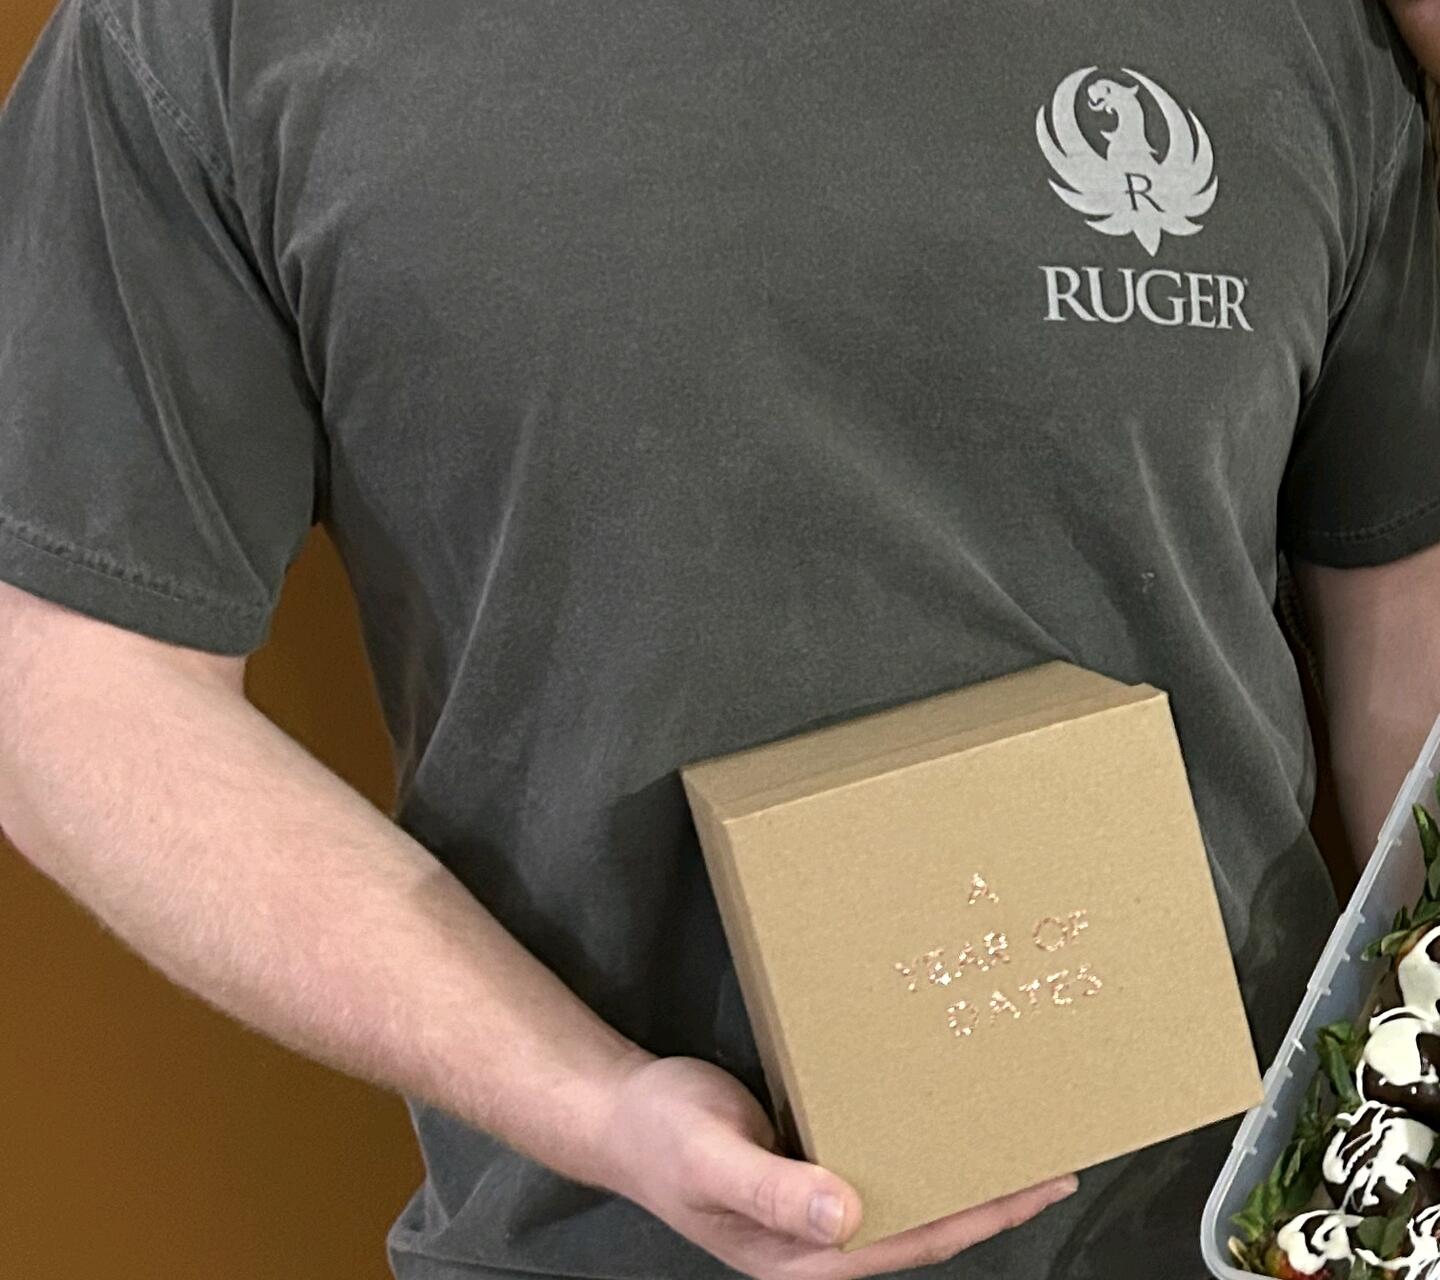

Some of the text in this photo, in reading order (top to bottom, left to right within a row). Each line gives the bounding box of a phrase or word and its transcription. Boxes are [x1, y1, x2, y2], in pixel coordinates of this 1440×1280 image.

[1124, 172, 1166, 213] R
[1038, 265, 1254, 332] RUGER
[967, 872, 999, 905] A
[894, 909, 1089, 993] YEAR OF
[948, 963, 1103, 1037] DATES
